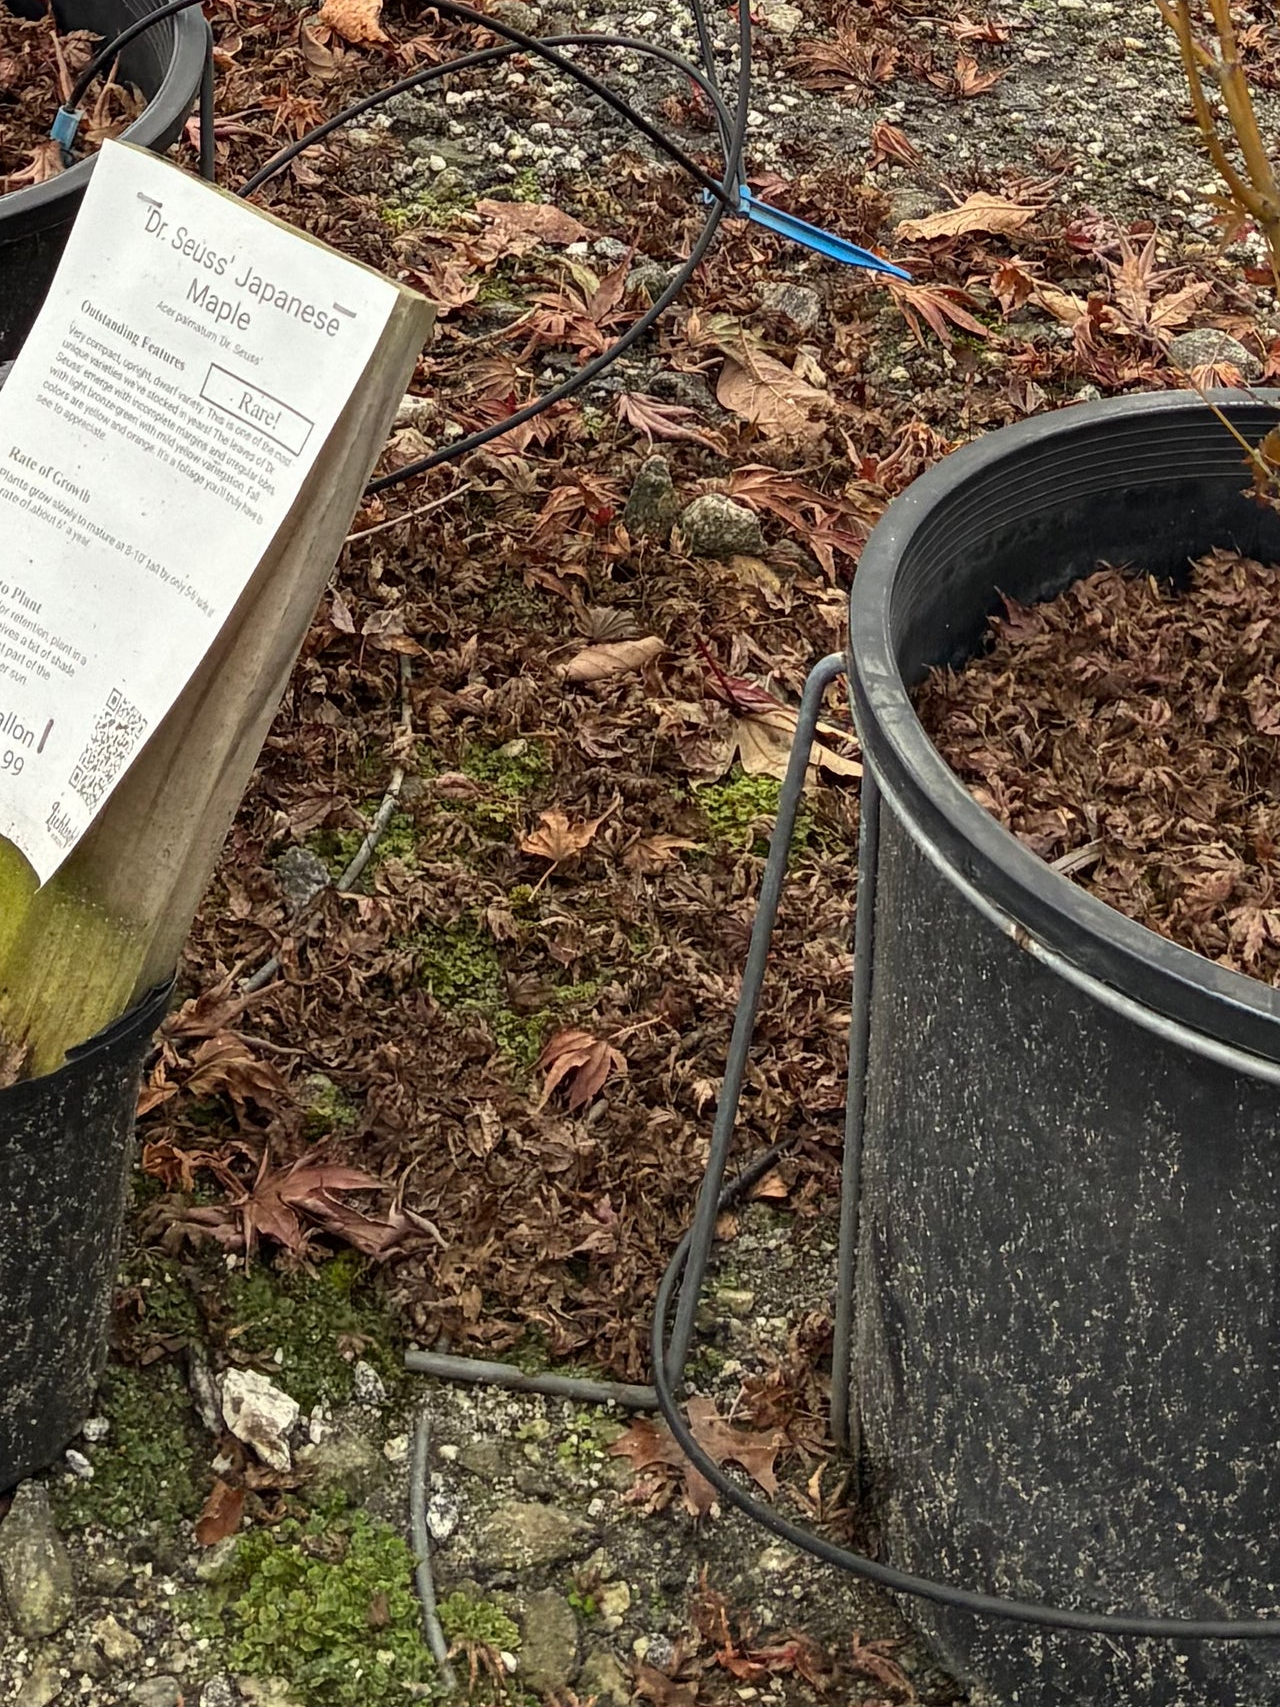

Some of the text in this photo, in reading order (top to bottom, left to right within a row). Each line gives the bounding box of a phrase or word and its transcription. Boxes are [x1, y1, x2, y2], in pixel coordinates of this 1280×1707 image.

[144, 205, 340, 337] 'Dr. Seuss' Japanese
[155, 300, 177, 317] Acer
[174, 312, 218, 343] palmatum
[186, 277, 251, 331] Maple
[80, 299, 186, 372] Outstanding Features
[35, 394, 54, 409] see
[53, 402, 64, 415] to
[42, 380, 71, 401] colors
[69, 396, 85, 410] are
[82, 403, 112, 426] yellow
[110, 420, 130, 436] and
[61, 339, 90, 362] unique
[89, 356, 124, 381] varieties
[123, 375, 147, 396] we've
[146, 390, 181, 416] stocked
[213, 427, 230, 446] The
[68, 321, 87, 344] Very
[85, 336, 122, 366] compact,
[122, 358, 152, 384] upright,
[152, 375, 180, 396] dwarf
[207, 407, 226, 426] This
[225, 420, 235, 432] is
[234, 426, 253, 442] one
[251, 436, 264, 448] of
[237, 391, 282, 430] Rare!
[49, 366, 70, 383] with
[67, 375, 88, 395] light
[138, 419, 157, 437] with
[173, 442, 202, 464] yellow
[83, 369, 114, 393] emerge
[113, 387, 133, 404] with
[131, 396, 177, 431] incomplete
[208, 445, 228, 462] and
[8, 446, 91, 504] Rate of Growth
[18, 498, 33, 511] of
[29, 504, 57, 526] about
[65, 525, 73, 536] a
[28, 486, 53, 505] grow
[51, 499, 79, 523] slowly
[76, 514, 88, 527] to
[85, 521, 116, 546] mature
[114, 540, 126, 552] at
[159, 566, 172, 583] by
[10, 586, 43, 615] Plant
[3, 647, 27, 665] part
[25, 659, 38, 671] of
[35, 663, 51, 681] the
[9, 611, 49, 643] retention,
[49, 636, 73, 656] plant
[71, 648, 82, 662] in
[79, 655, 88, 667] a
[19, 636, 28, 647] a
[27, 638, 41, 655] bit
[39, 649, 53, 661] of
[50, 655, 75, 678] shade
